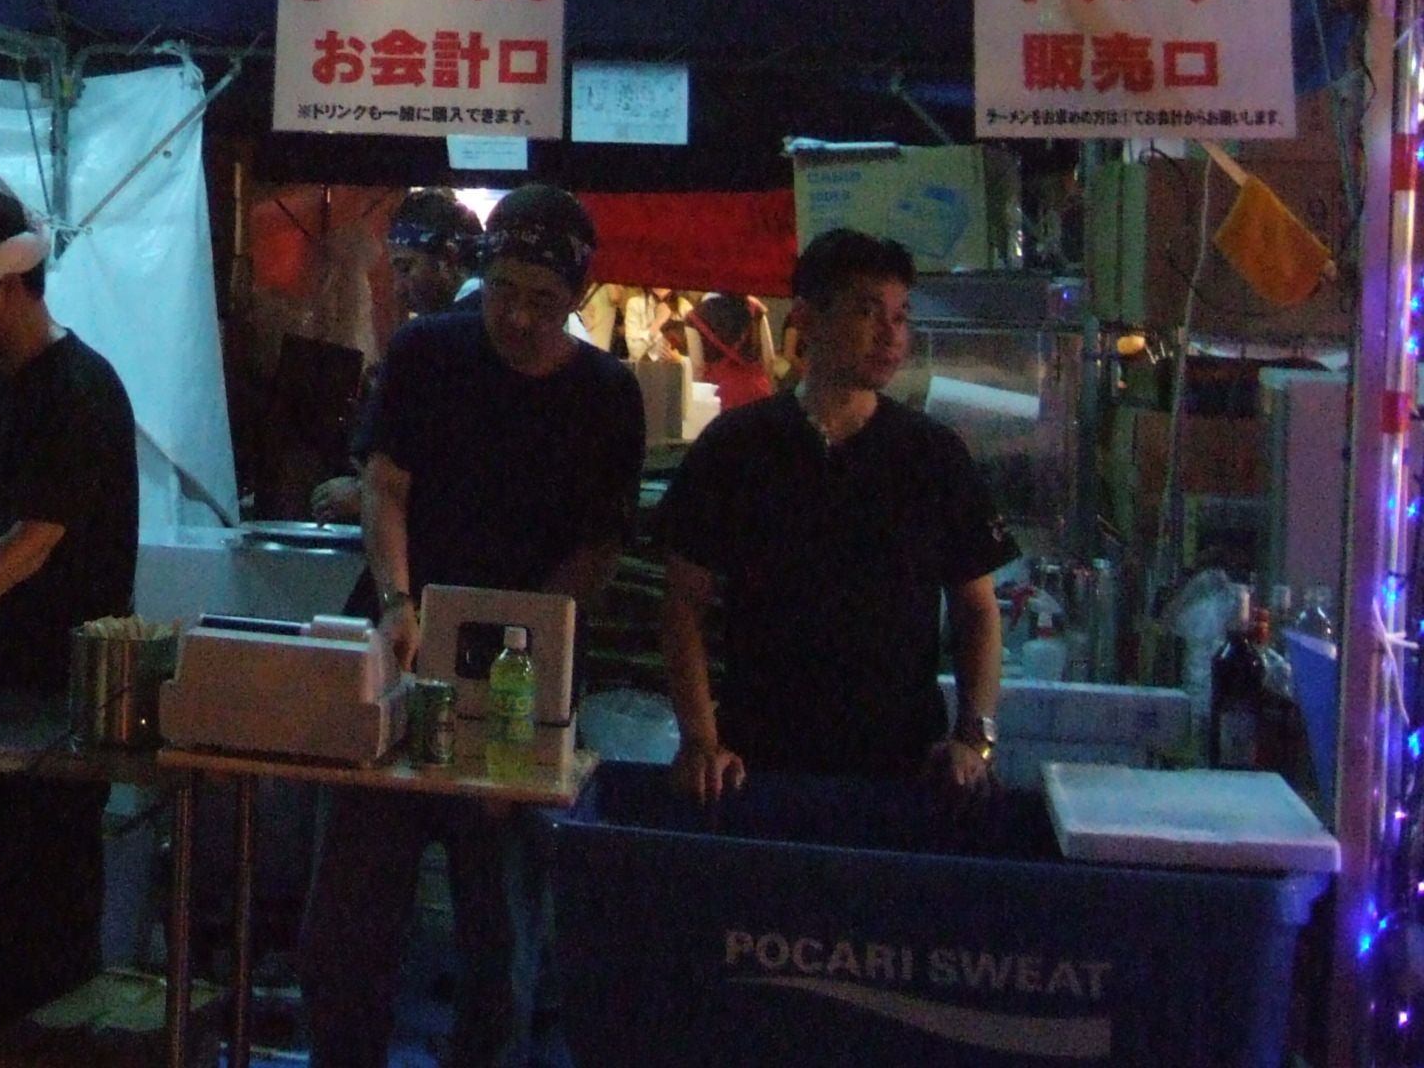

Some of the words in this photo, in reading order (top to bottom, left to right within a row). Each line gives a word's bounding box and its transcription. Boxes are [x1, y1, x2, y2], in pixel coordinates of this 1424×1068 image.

[311, 29, 549, 89] お会計口
[1022, 32, 1219, 92] 販売口
[724, 930, 914, 981] POCARI
[927, 947, 1112, 1001] SWEAT
